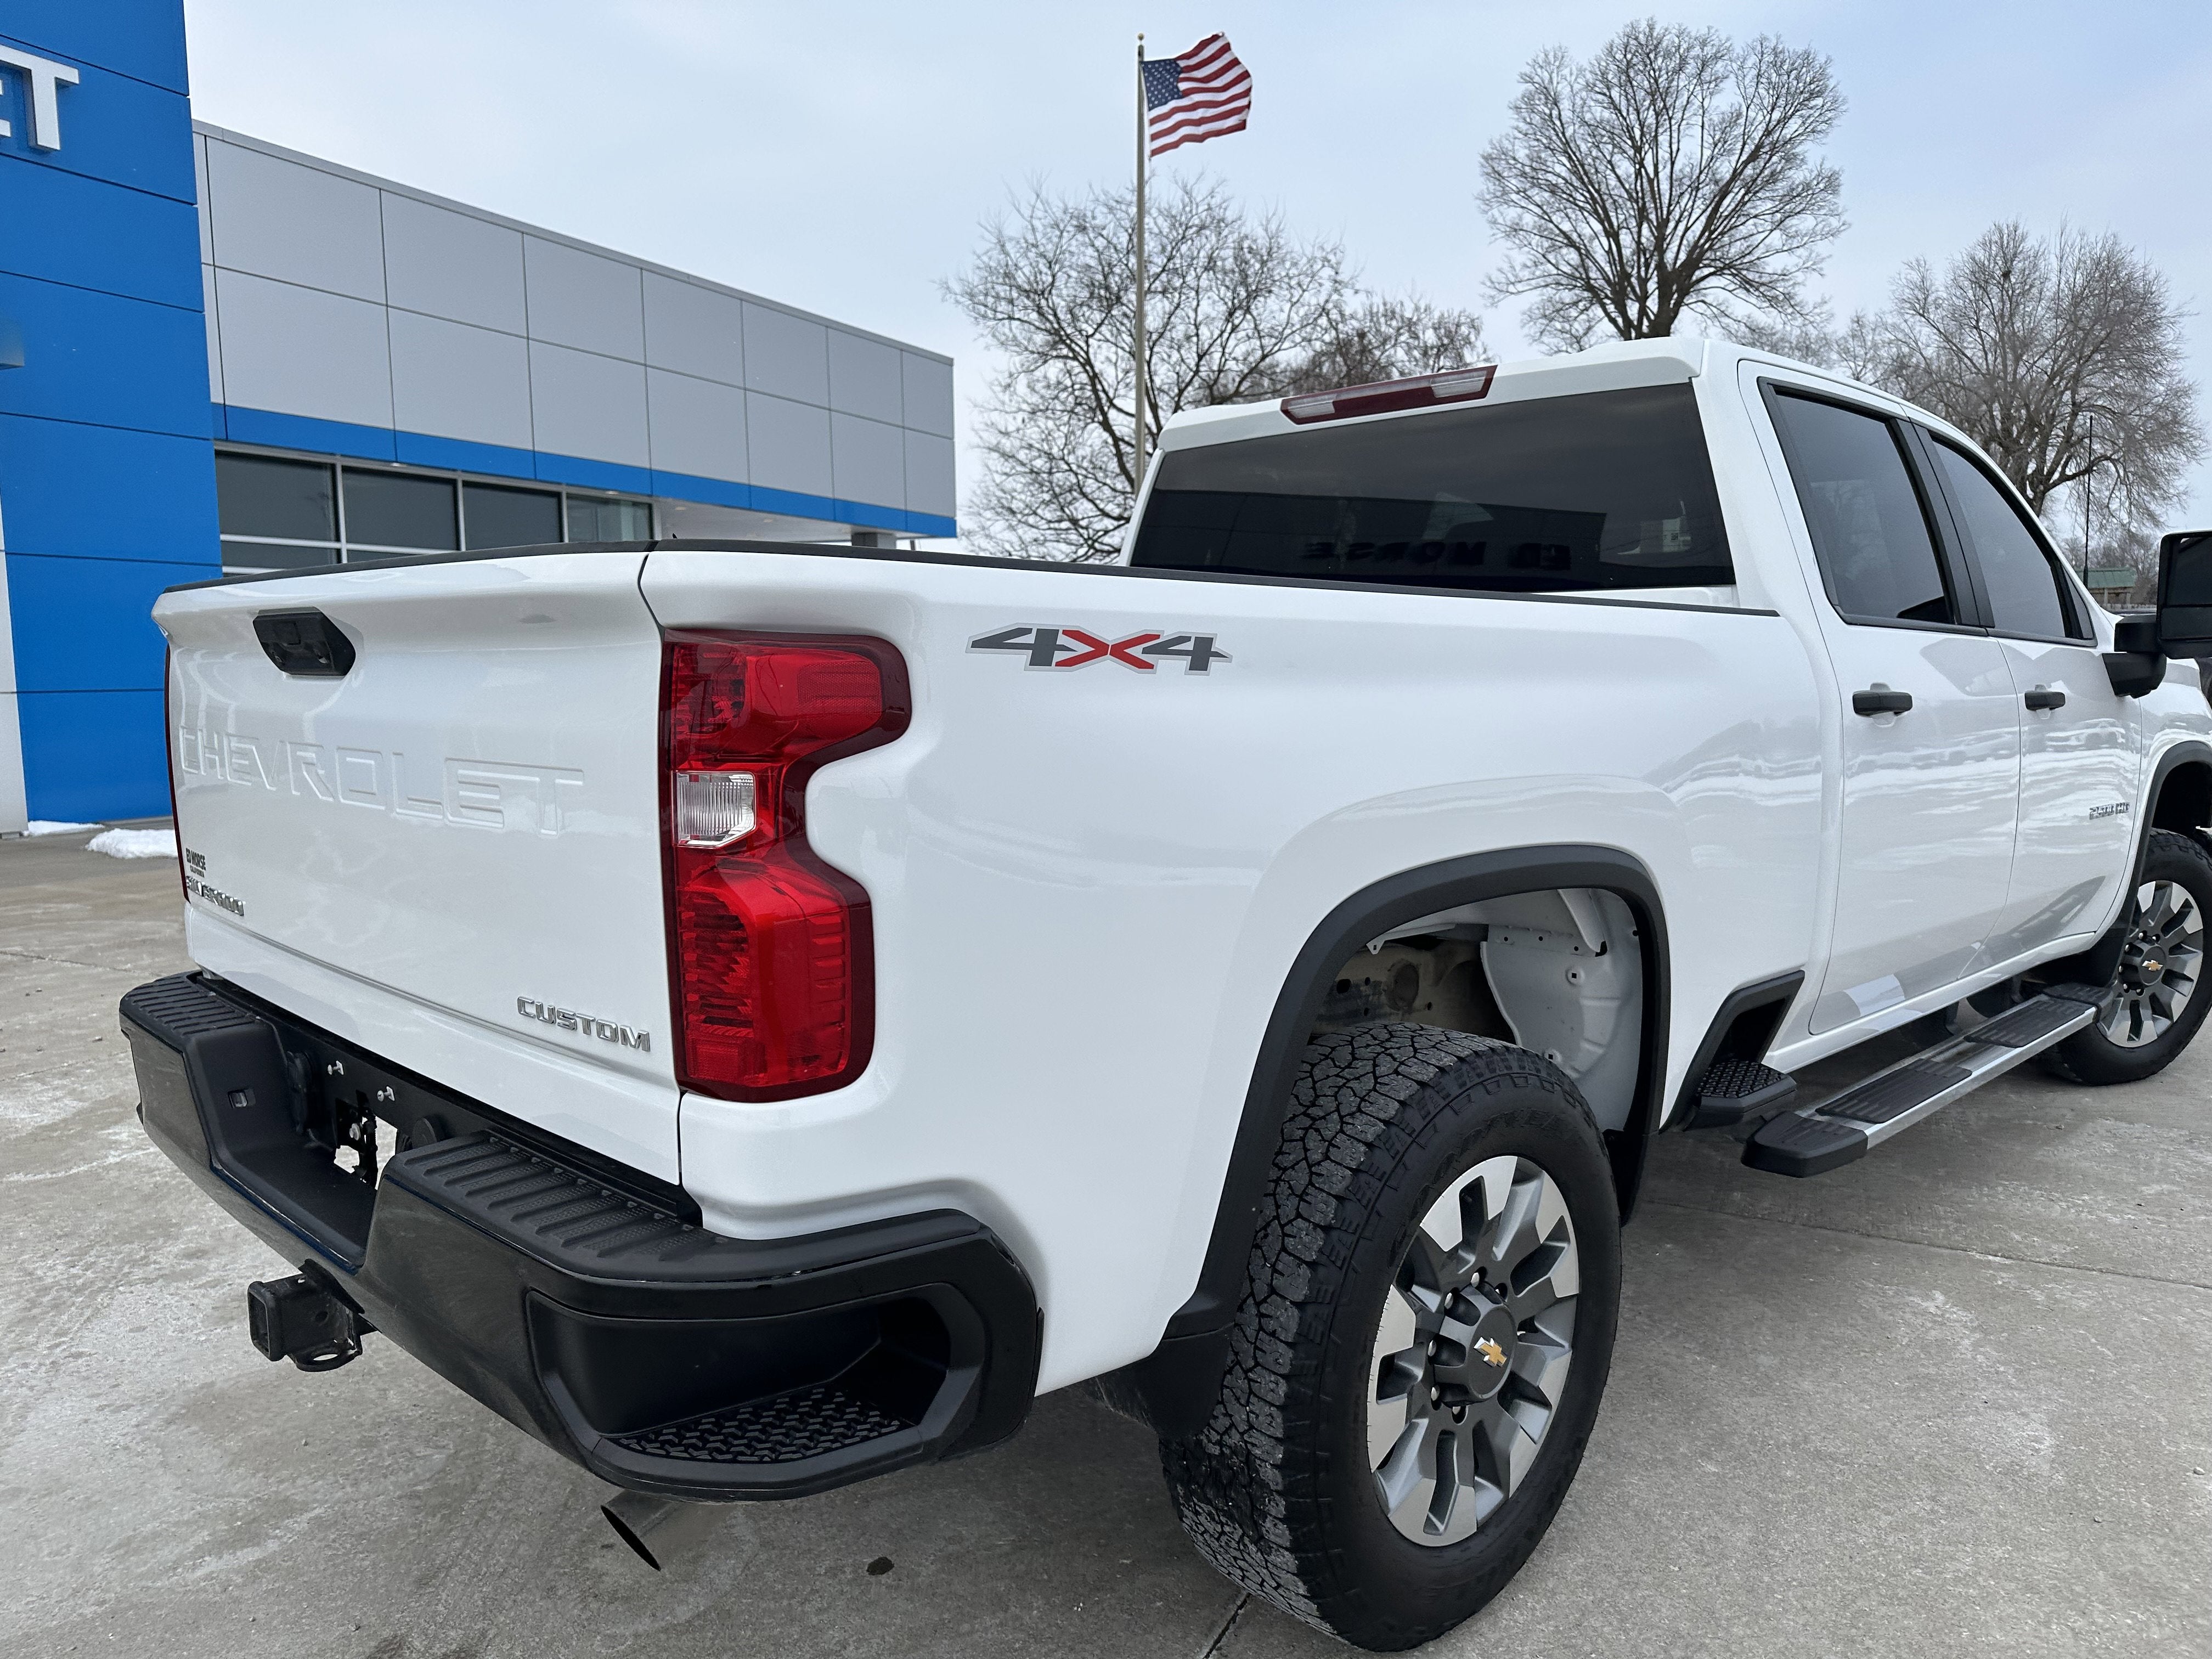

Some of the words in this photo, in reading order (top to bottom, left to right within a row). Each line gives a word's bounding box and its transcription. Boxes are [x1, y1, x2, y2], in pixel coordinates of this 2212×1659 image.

[178, 725, 585, 838] CHEVROLET
[185, 848, 191, 864] ED
[191, 850, 206, 871] MORSE
[517, 996, 651, 1052] CUSTOM
